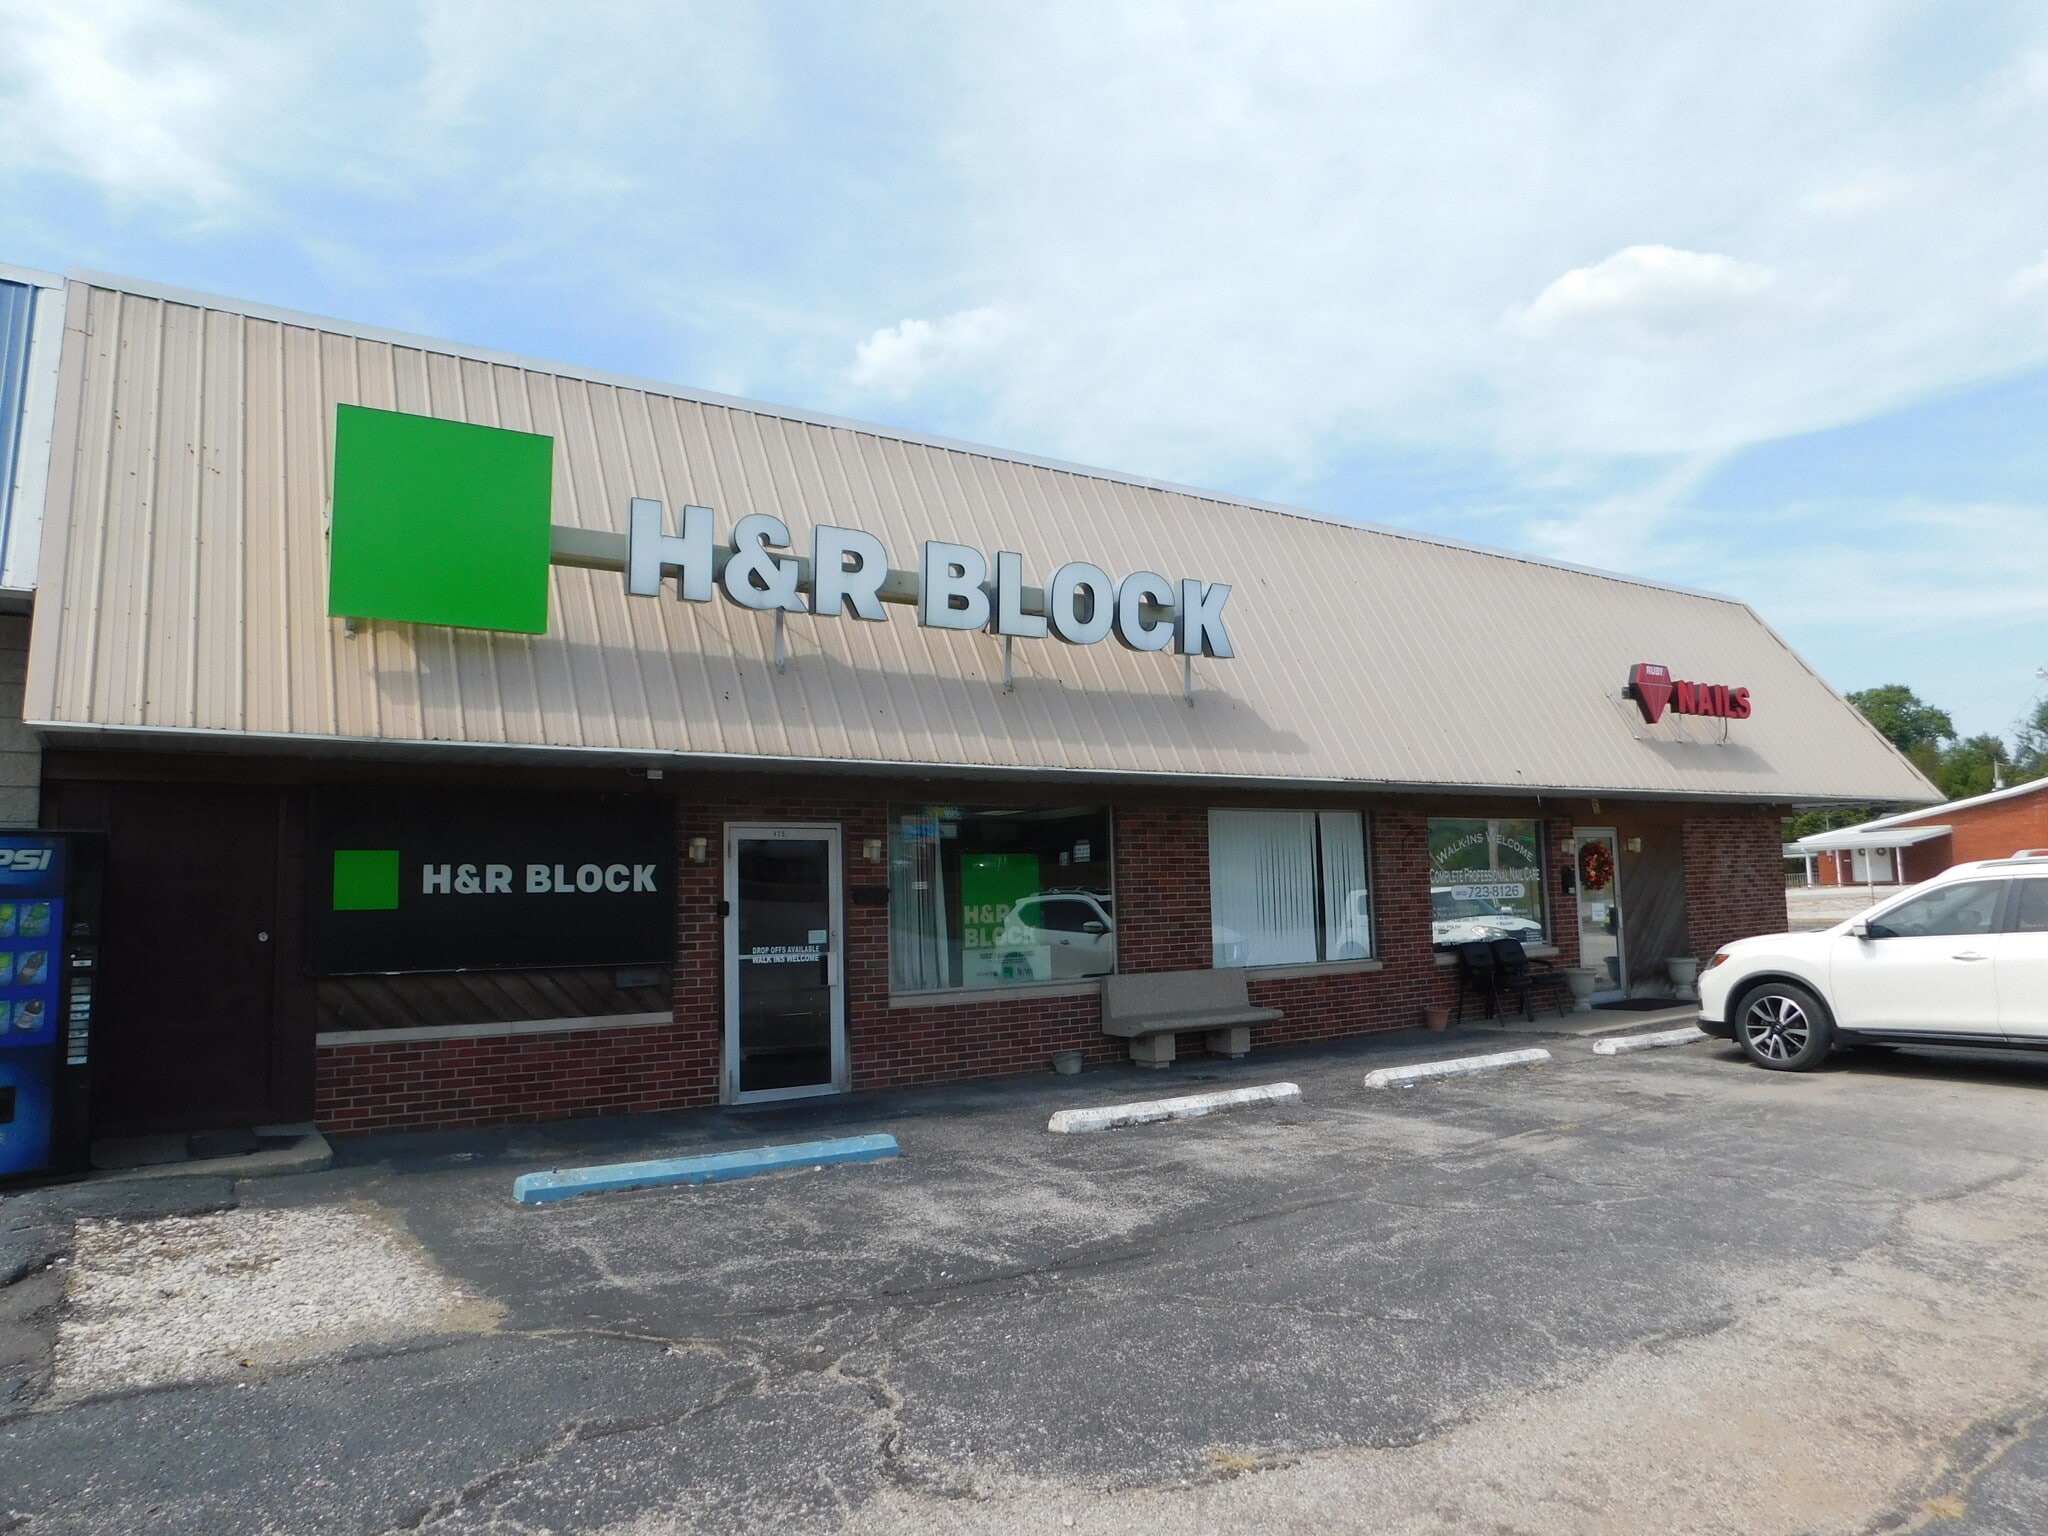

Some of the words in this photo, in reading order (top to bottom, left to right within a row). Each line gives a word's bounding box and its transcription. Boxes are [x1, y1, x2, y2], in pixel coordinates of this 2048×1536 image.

[625, 497, 888, 622] H&R
[917, 540, 1235, 658] BLOCK
[1645, 665, 1664, 675] RUBY
[1676, 680, 1751, 719] NAILS
[1436, 833, 1483, 864] WALK-INS
[1485, 830, 1534, 862] WELCOME
[422, 864, 513, 894] H&R
[526, 863, 658, 893] BLOCK
[1429, 868, 1464, 884] COMPLETE
[1468, 885, 1520, 898] 723-8126
[963, 903, 1011, 925] H&R
[964, 926, 1037, 948] BLOCK
[752, 955, 772, 964] WALK
[786, 953, 820, 963] WELCOME
[770, 946, 786, 954] OFFS
[787, 945, 820, 953] AVAILABLE
